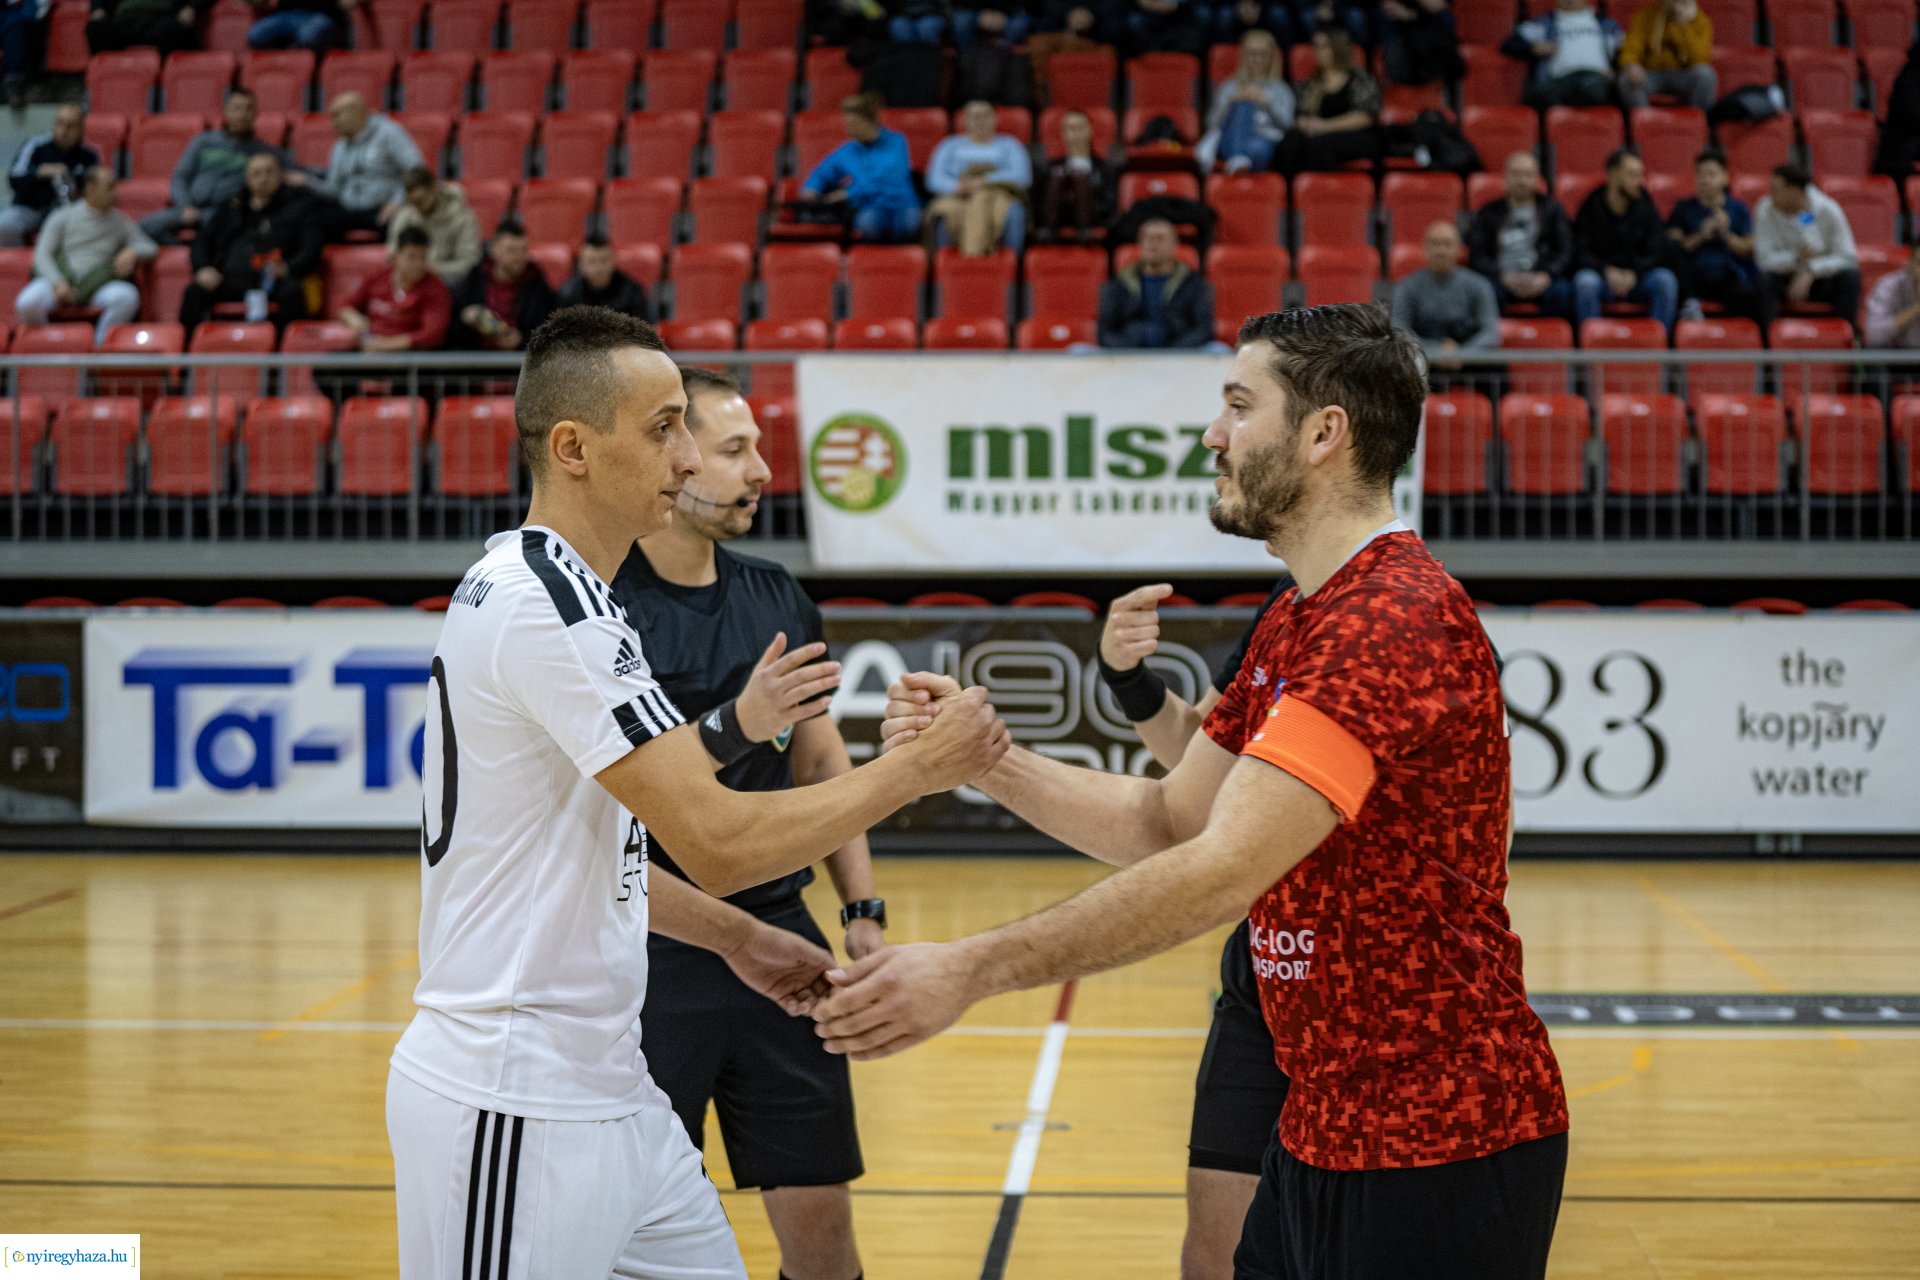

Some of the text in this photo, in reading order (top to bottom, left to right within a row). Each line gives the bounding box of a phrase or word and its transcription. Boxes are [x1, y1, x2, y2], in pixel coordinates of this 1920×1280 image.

[947, 415, 1217, 479] mlsz
[1780, 648, 1846, 687] the
[122, 652, 430, 791] Ta-T
[1752, 764, 1870, 796] water
